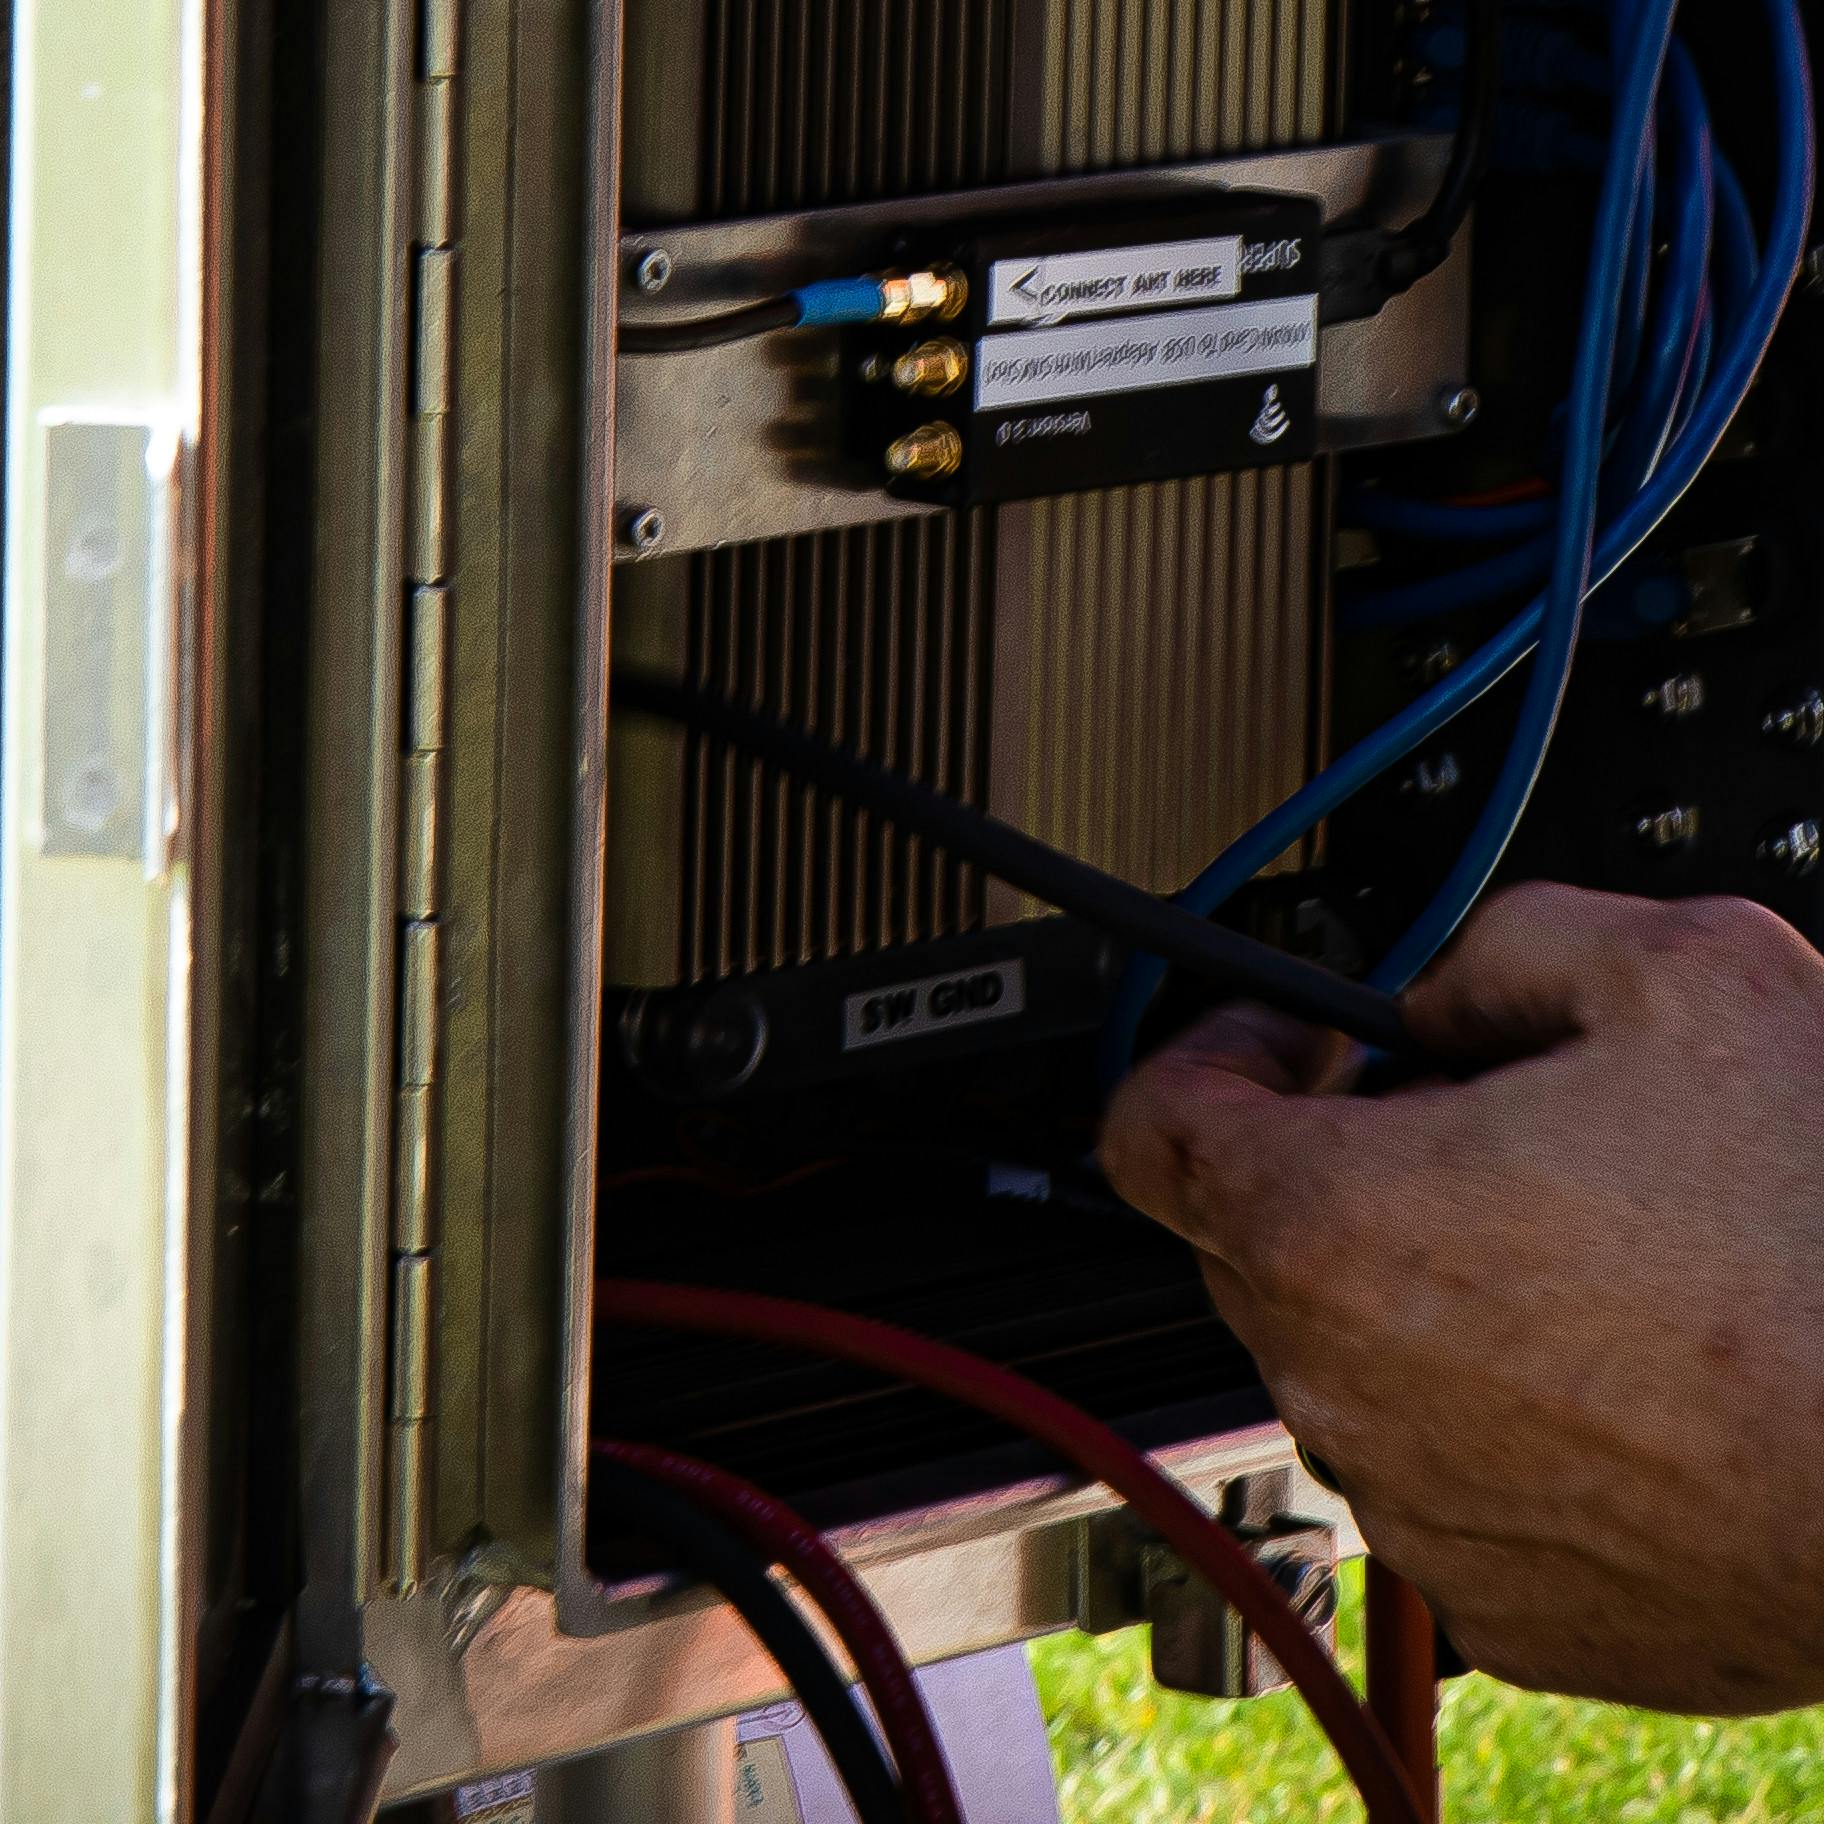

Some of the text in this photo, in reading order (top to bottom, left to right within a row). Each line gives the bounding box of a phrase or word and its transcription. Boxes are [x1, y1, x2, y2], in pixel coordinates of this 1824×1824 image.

[1039, 272, 1128, 308] CONNECT
[1172, 262, 1225, 293] HERE
[859, 969, 1005, 1036] SW GND
